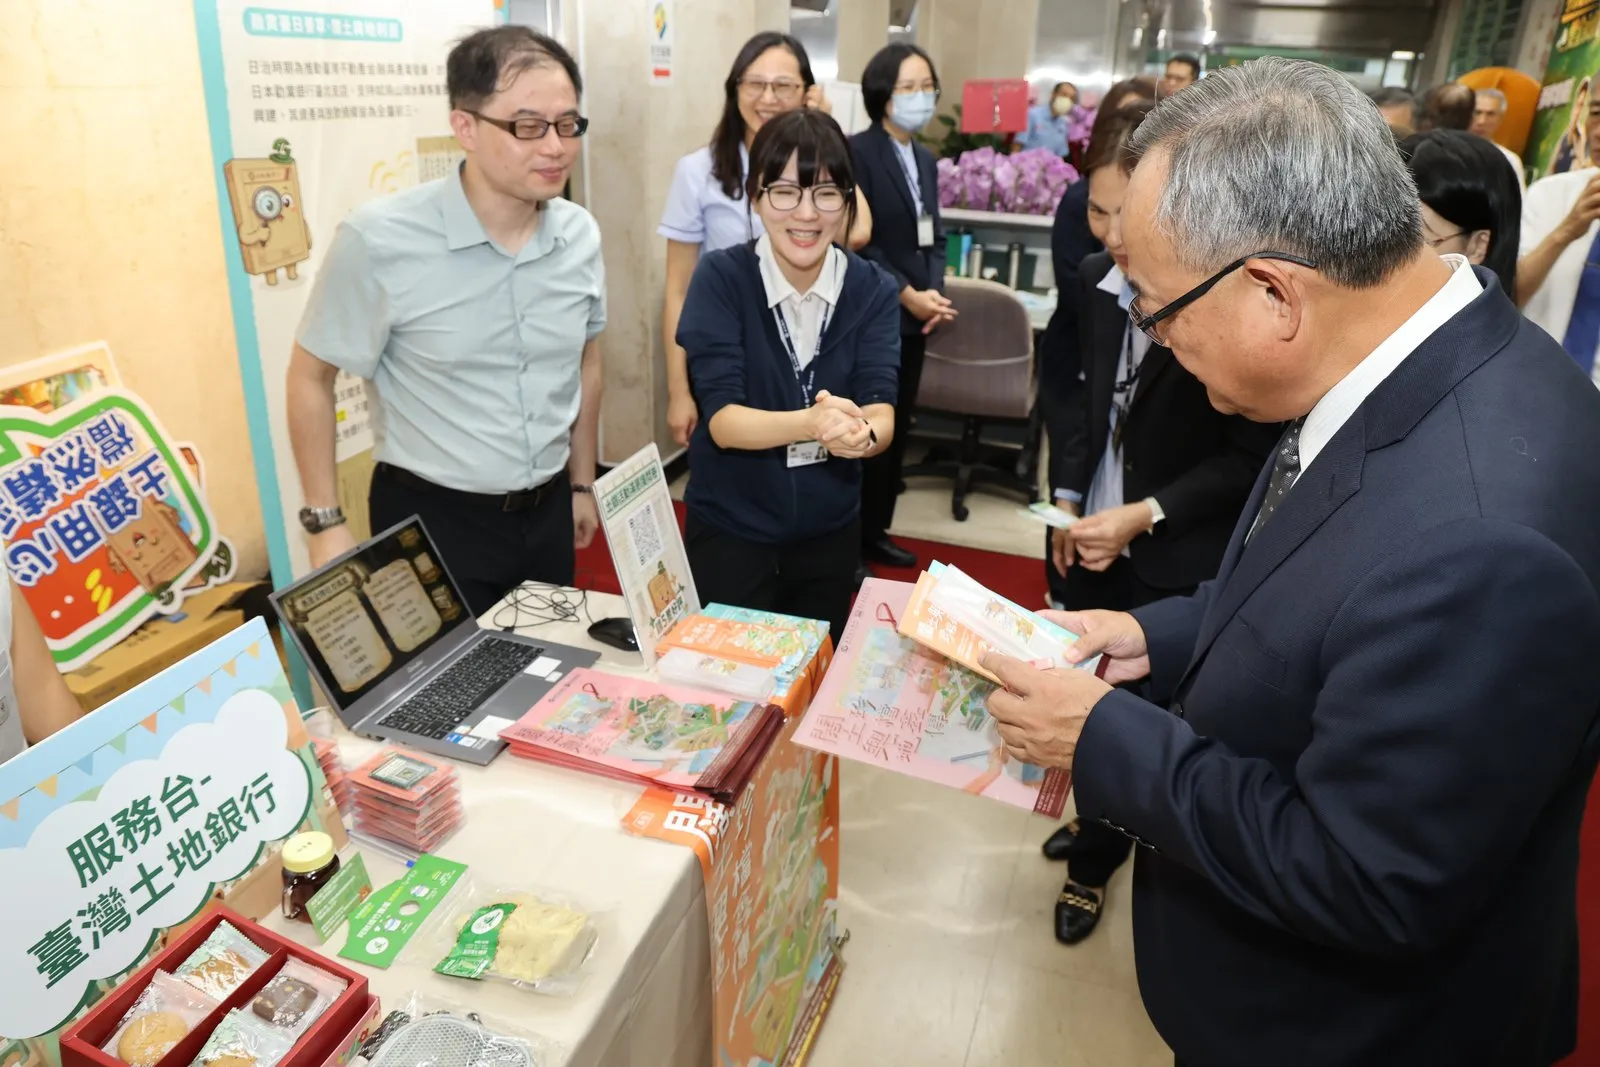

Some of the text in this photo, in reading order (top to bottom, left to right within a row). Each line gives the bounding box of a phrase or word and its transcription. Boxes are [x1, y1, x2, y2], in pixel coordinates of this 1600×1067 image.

[8, 452, 168, 583] 土銀用心
[26, 772, 277, 989] 臺灣土地銀行
